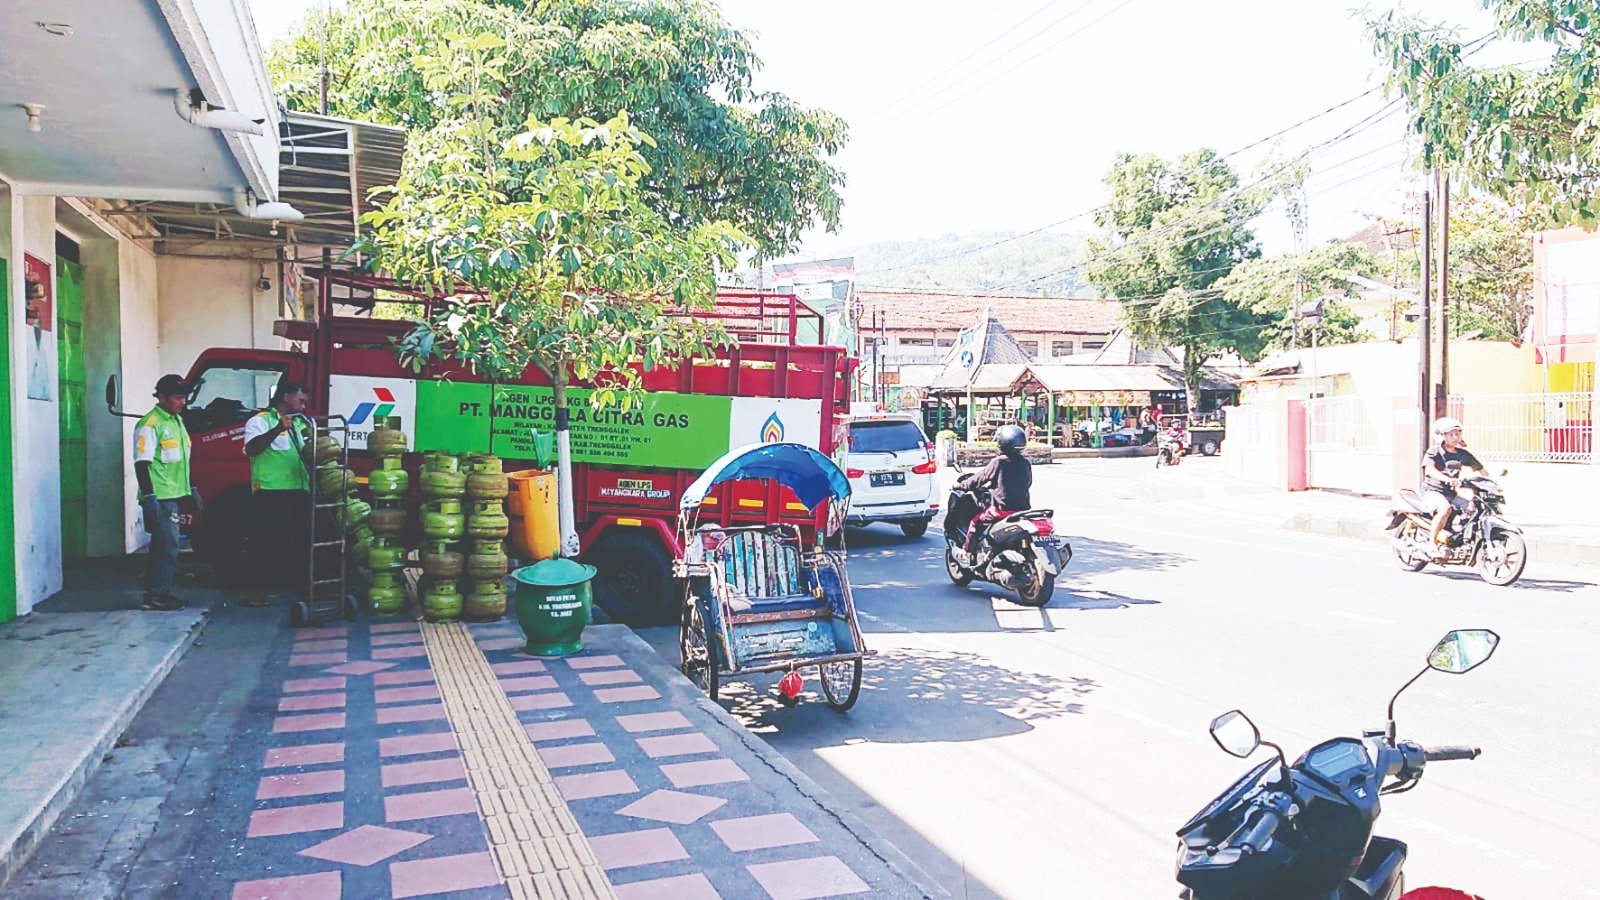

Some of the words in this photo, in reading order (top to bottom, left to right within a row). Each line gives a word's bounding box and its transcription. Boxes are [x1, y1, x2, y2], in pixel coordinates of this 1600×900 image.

[535, 395, 555, 405] LPG
[566, 397, 580, 407] KG
[459, 402, 483, 417] PT.
[489, 403, 587, 422] MANGGLA
[593, 409, 645, 426] CITRA
[653, 413, 689, 428] GAS
[587, 425, 630, 434] TRENGGALEK
[618, 480, 636, 488] AGEN
[637, 481, 651, 489] LPG
[647, 489, 671, 498] GROUP
